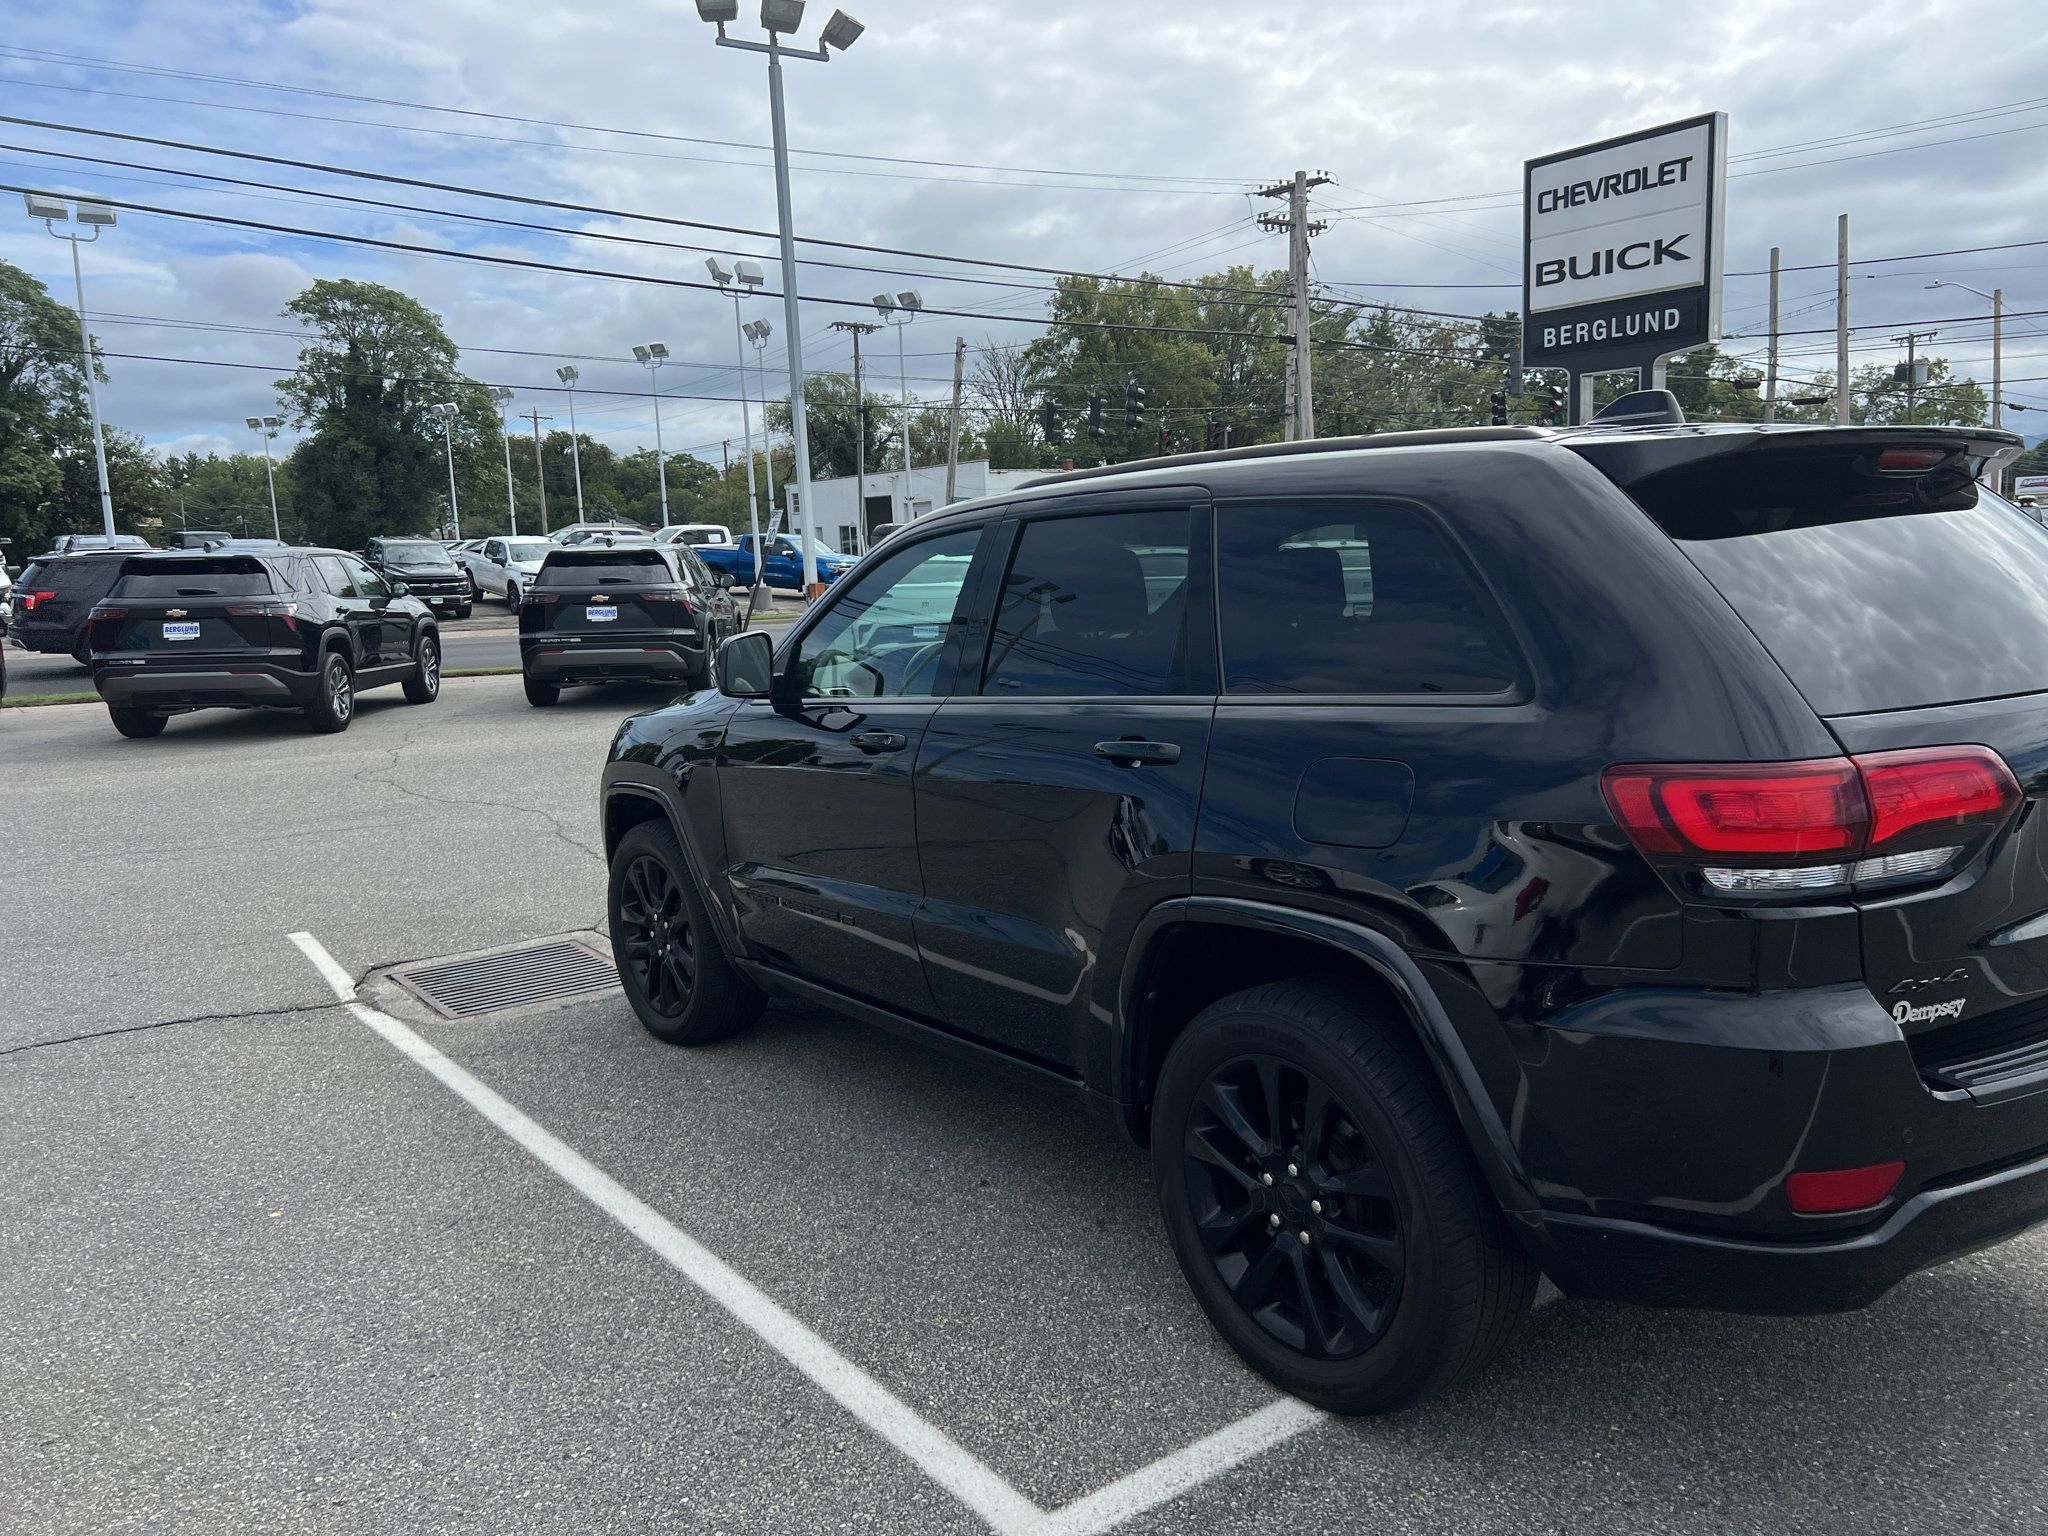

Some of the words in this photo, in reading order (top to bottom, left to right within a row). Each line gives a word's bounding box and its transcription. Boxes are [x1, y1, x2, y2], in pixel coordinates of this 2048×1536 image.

[1537, 156, 1693, 214] CHEVROLET
[1536, 233, 1692, 287] BUICK
[1543, 308, 1681, 348] BERGLUND
[164, 625, 199, 633] BERGLUND
[1892, 997, 1967, 1025] Dempsey
